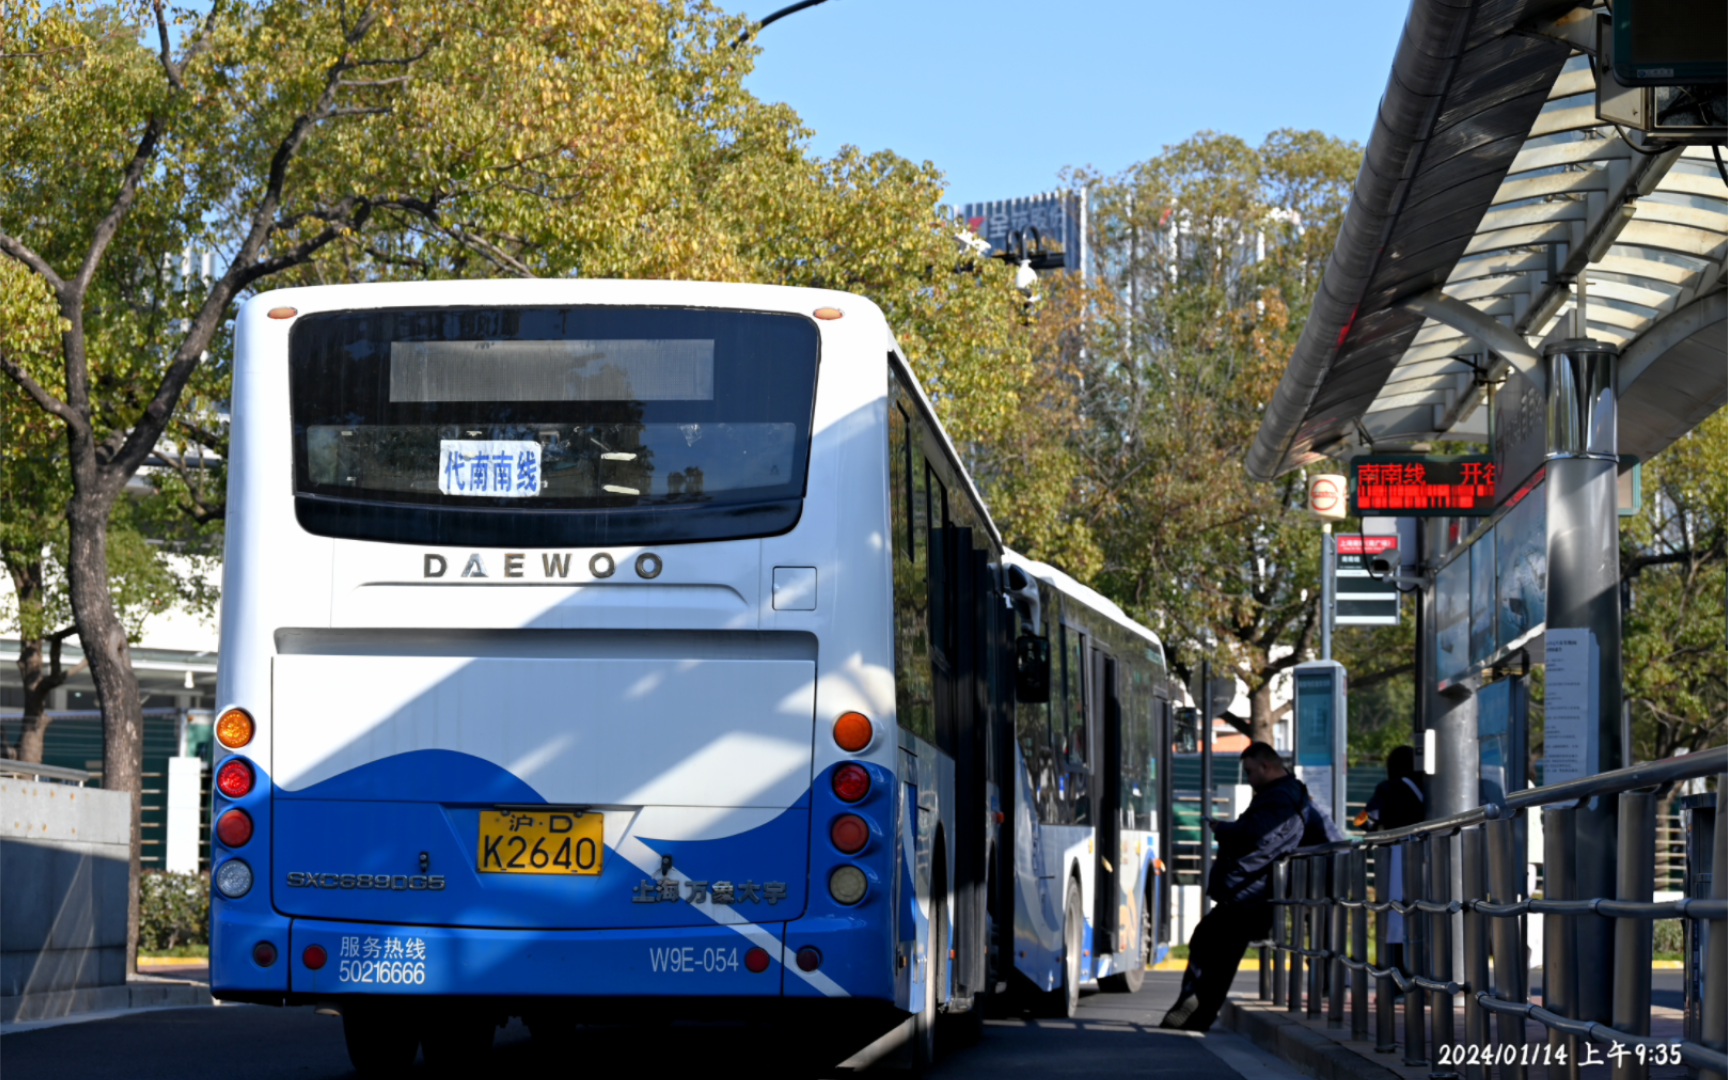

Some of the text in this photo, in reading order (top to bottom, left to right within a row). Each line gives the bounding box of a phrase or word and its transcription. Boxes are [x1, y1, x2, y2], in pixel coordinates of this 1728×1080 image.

[444, 450, 537, 492] 代南南线
[1357, 462, 1426, 485] 南南线
[423, 552, 663, 579] DAEWOO
[484, 835, 596, 870] K2640
[286, 872, 446, 891] SXC6890G5
[632, 879, 787, 905] 上海万象大宇
[340, 936, 426, 959] 服务热线
[649, 947, 739, 972] W9E-054
[339, 960, 426, 985] 50216666
